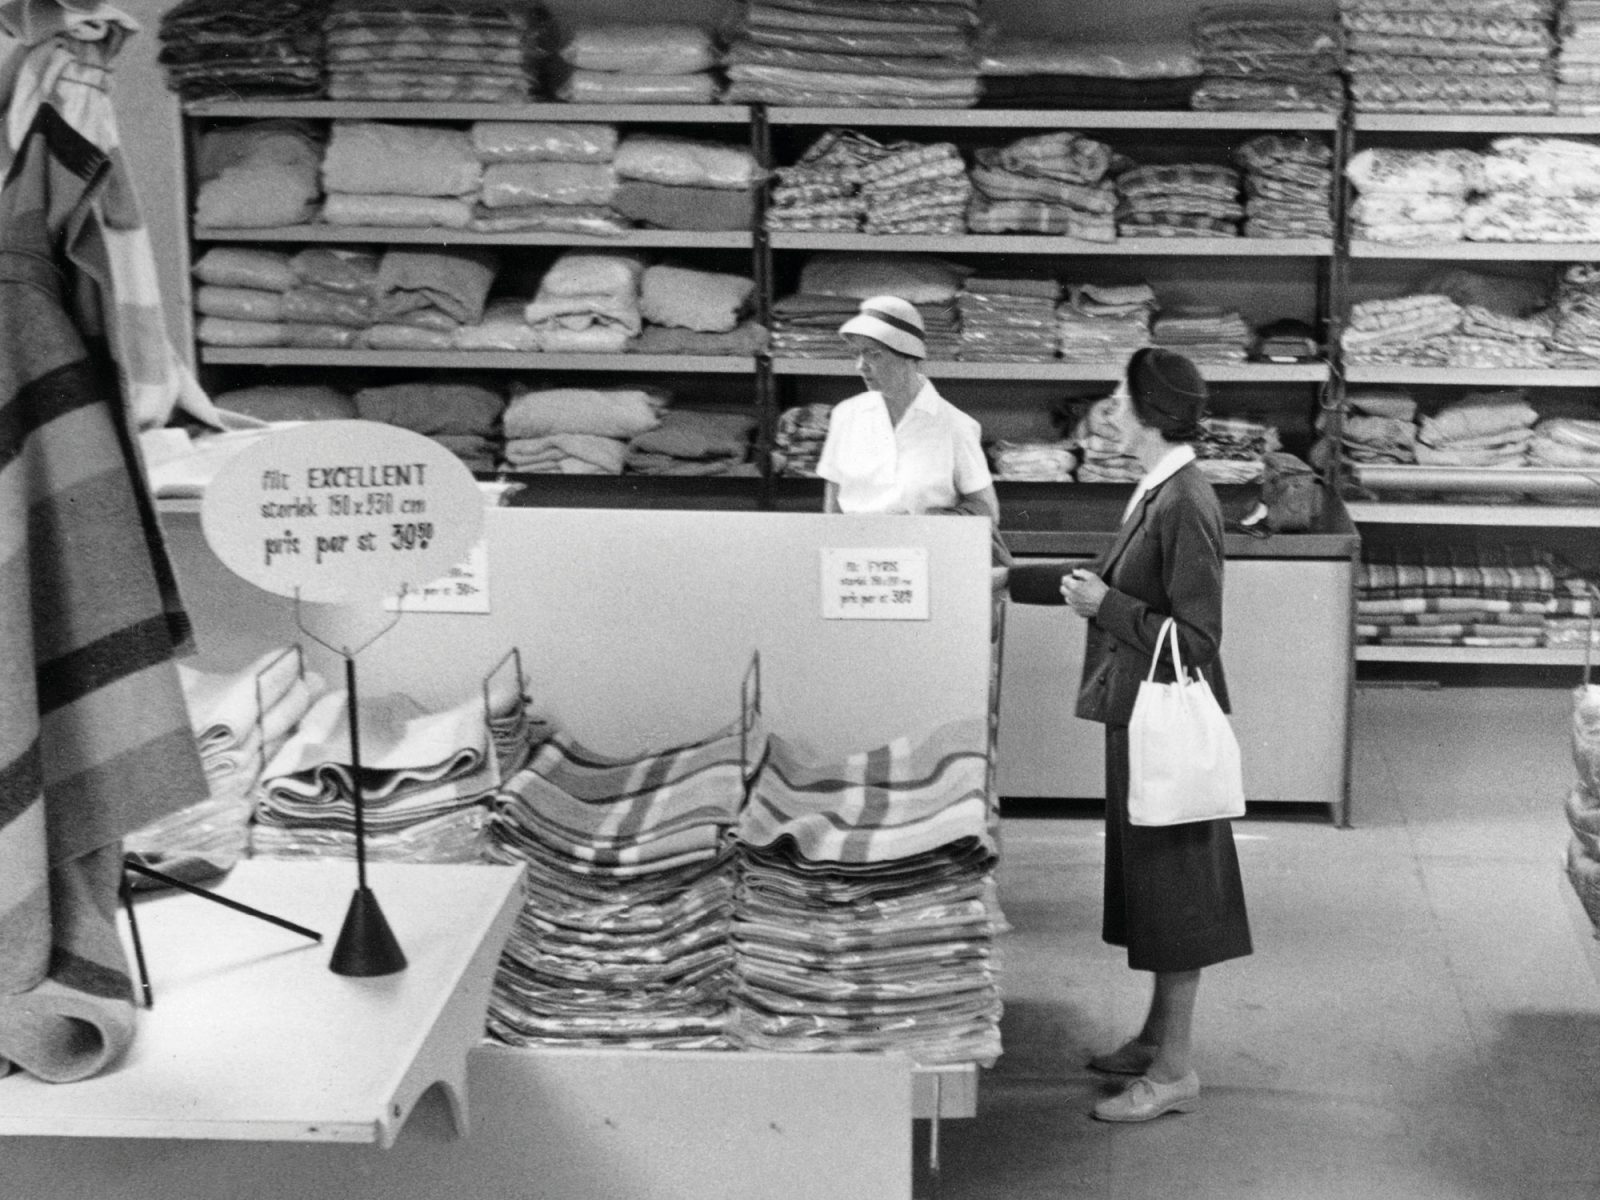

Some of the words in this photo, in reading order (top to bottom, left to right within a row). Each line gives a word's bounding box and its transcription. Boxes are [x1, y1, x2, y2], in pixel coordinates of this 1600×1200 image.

[308, 464, 428, 489] EXCELLENT
[400, 499, 427, 514] cm
[264, 529, 300, 566] pris
[316, 535, 349, 565] per
[357, 532, 377, 551] st
